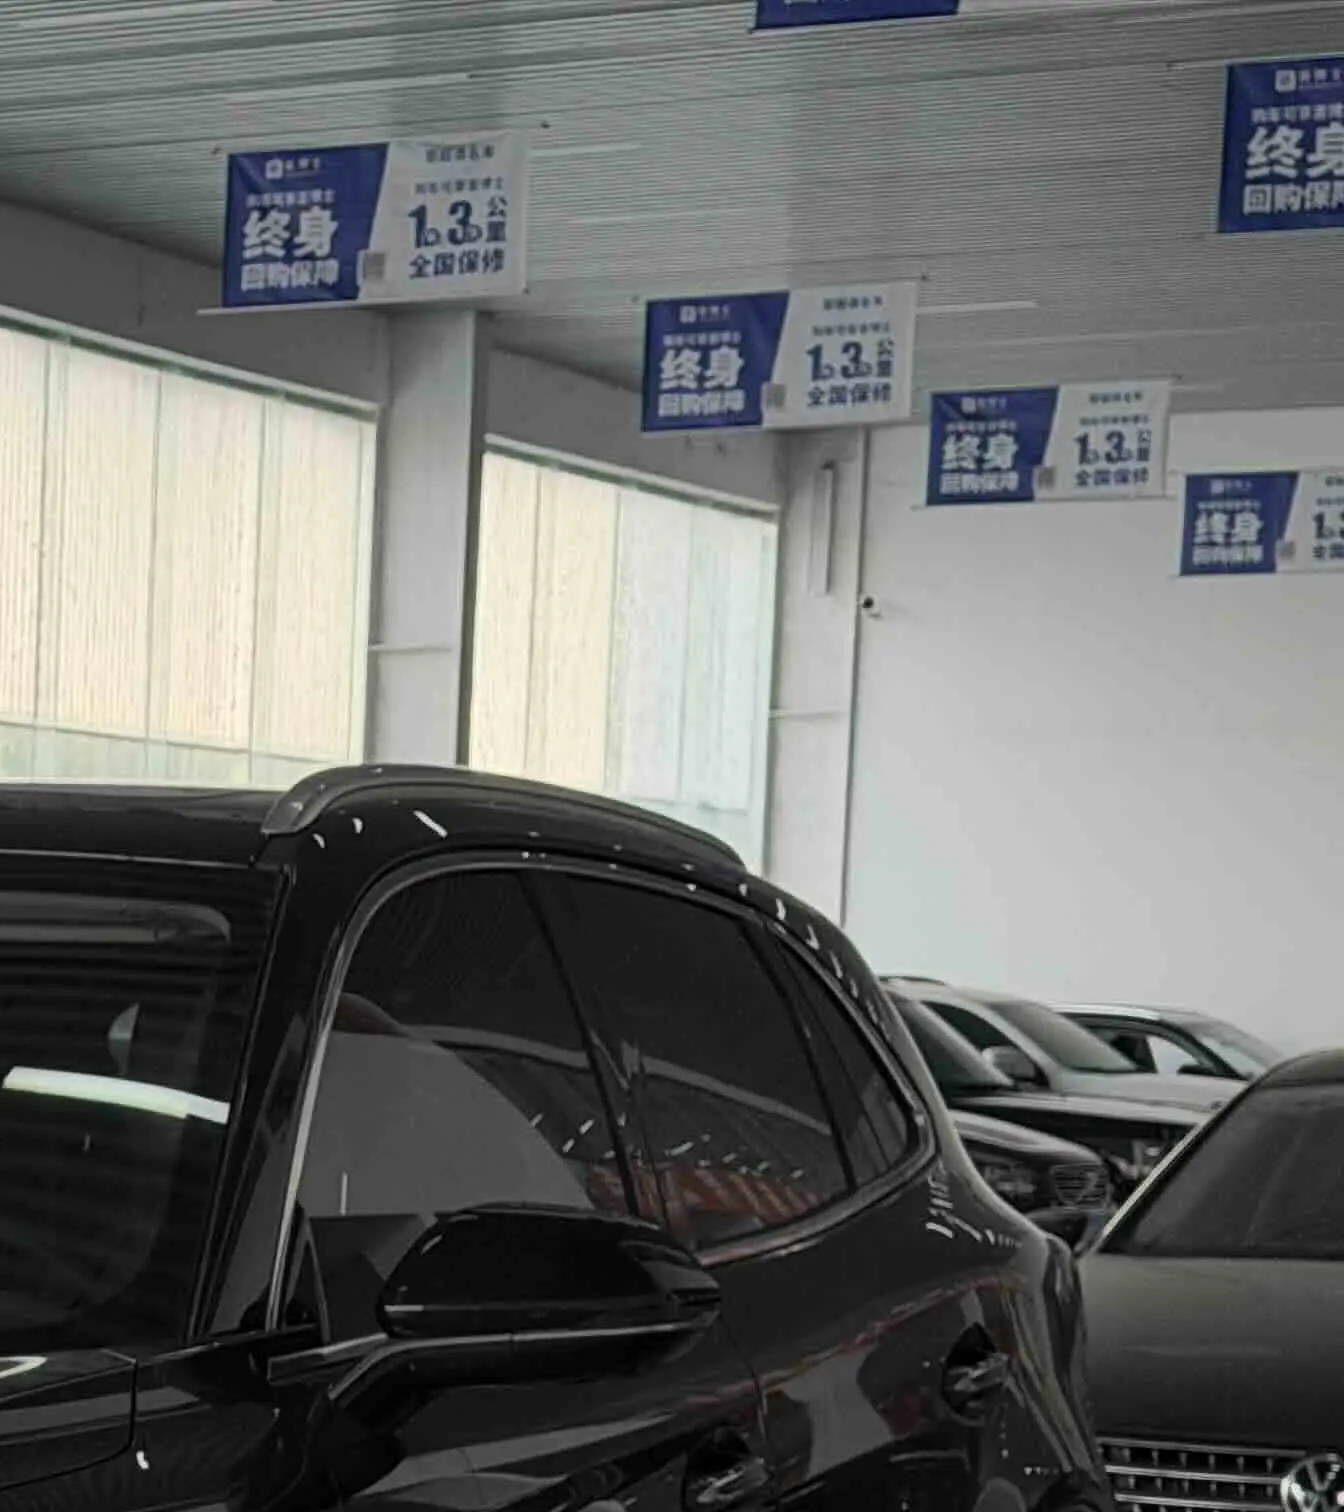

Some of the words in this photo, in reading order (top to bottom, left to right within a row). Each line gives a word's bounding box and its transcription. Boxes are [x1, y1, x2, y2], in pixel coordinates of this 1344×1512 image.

[1245, 121, 1344, 179] 终身
[241, 205, 339, 260] 终身
[240, 258, 340, 292] 回购保障
[409, 249, 505, 280] 全国保修
[659, 344, 745, 390] 终身
